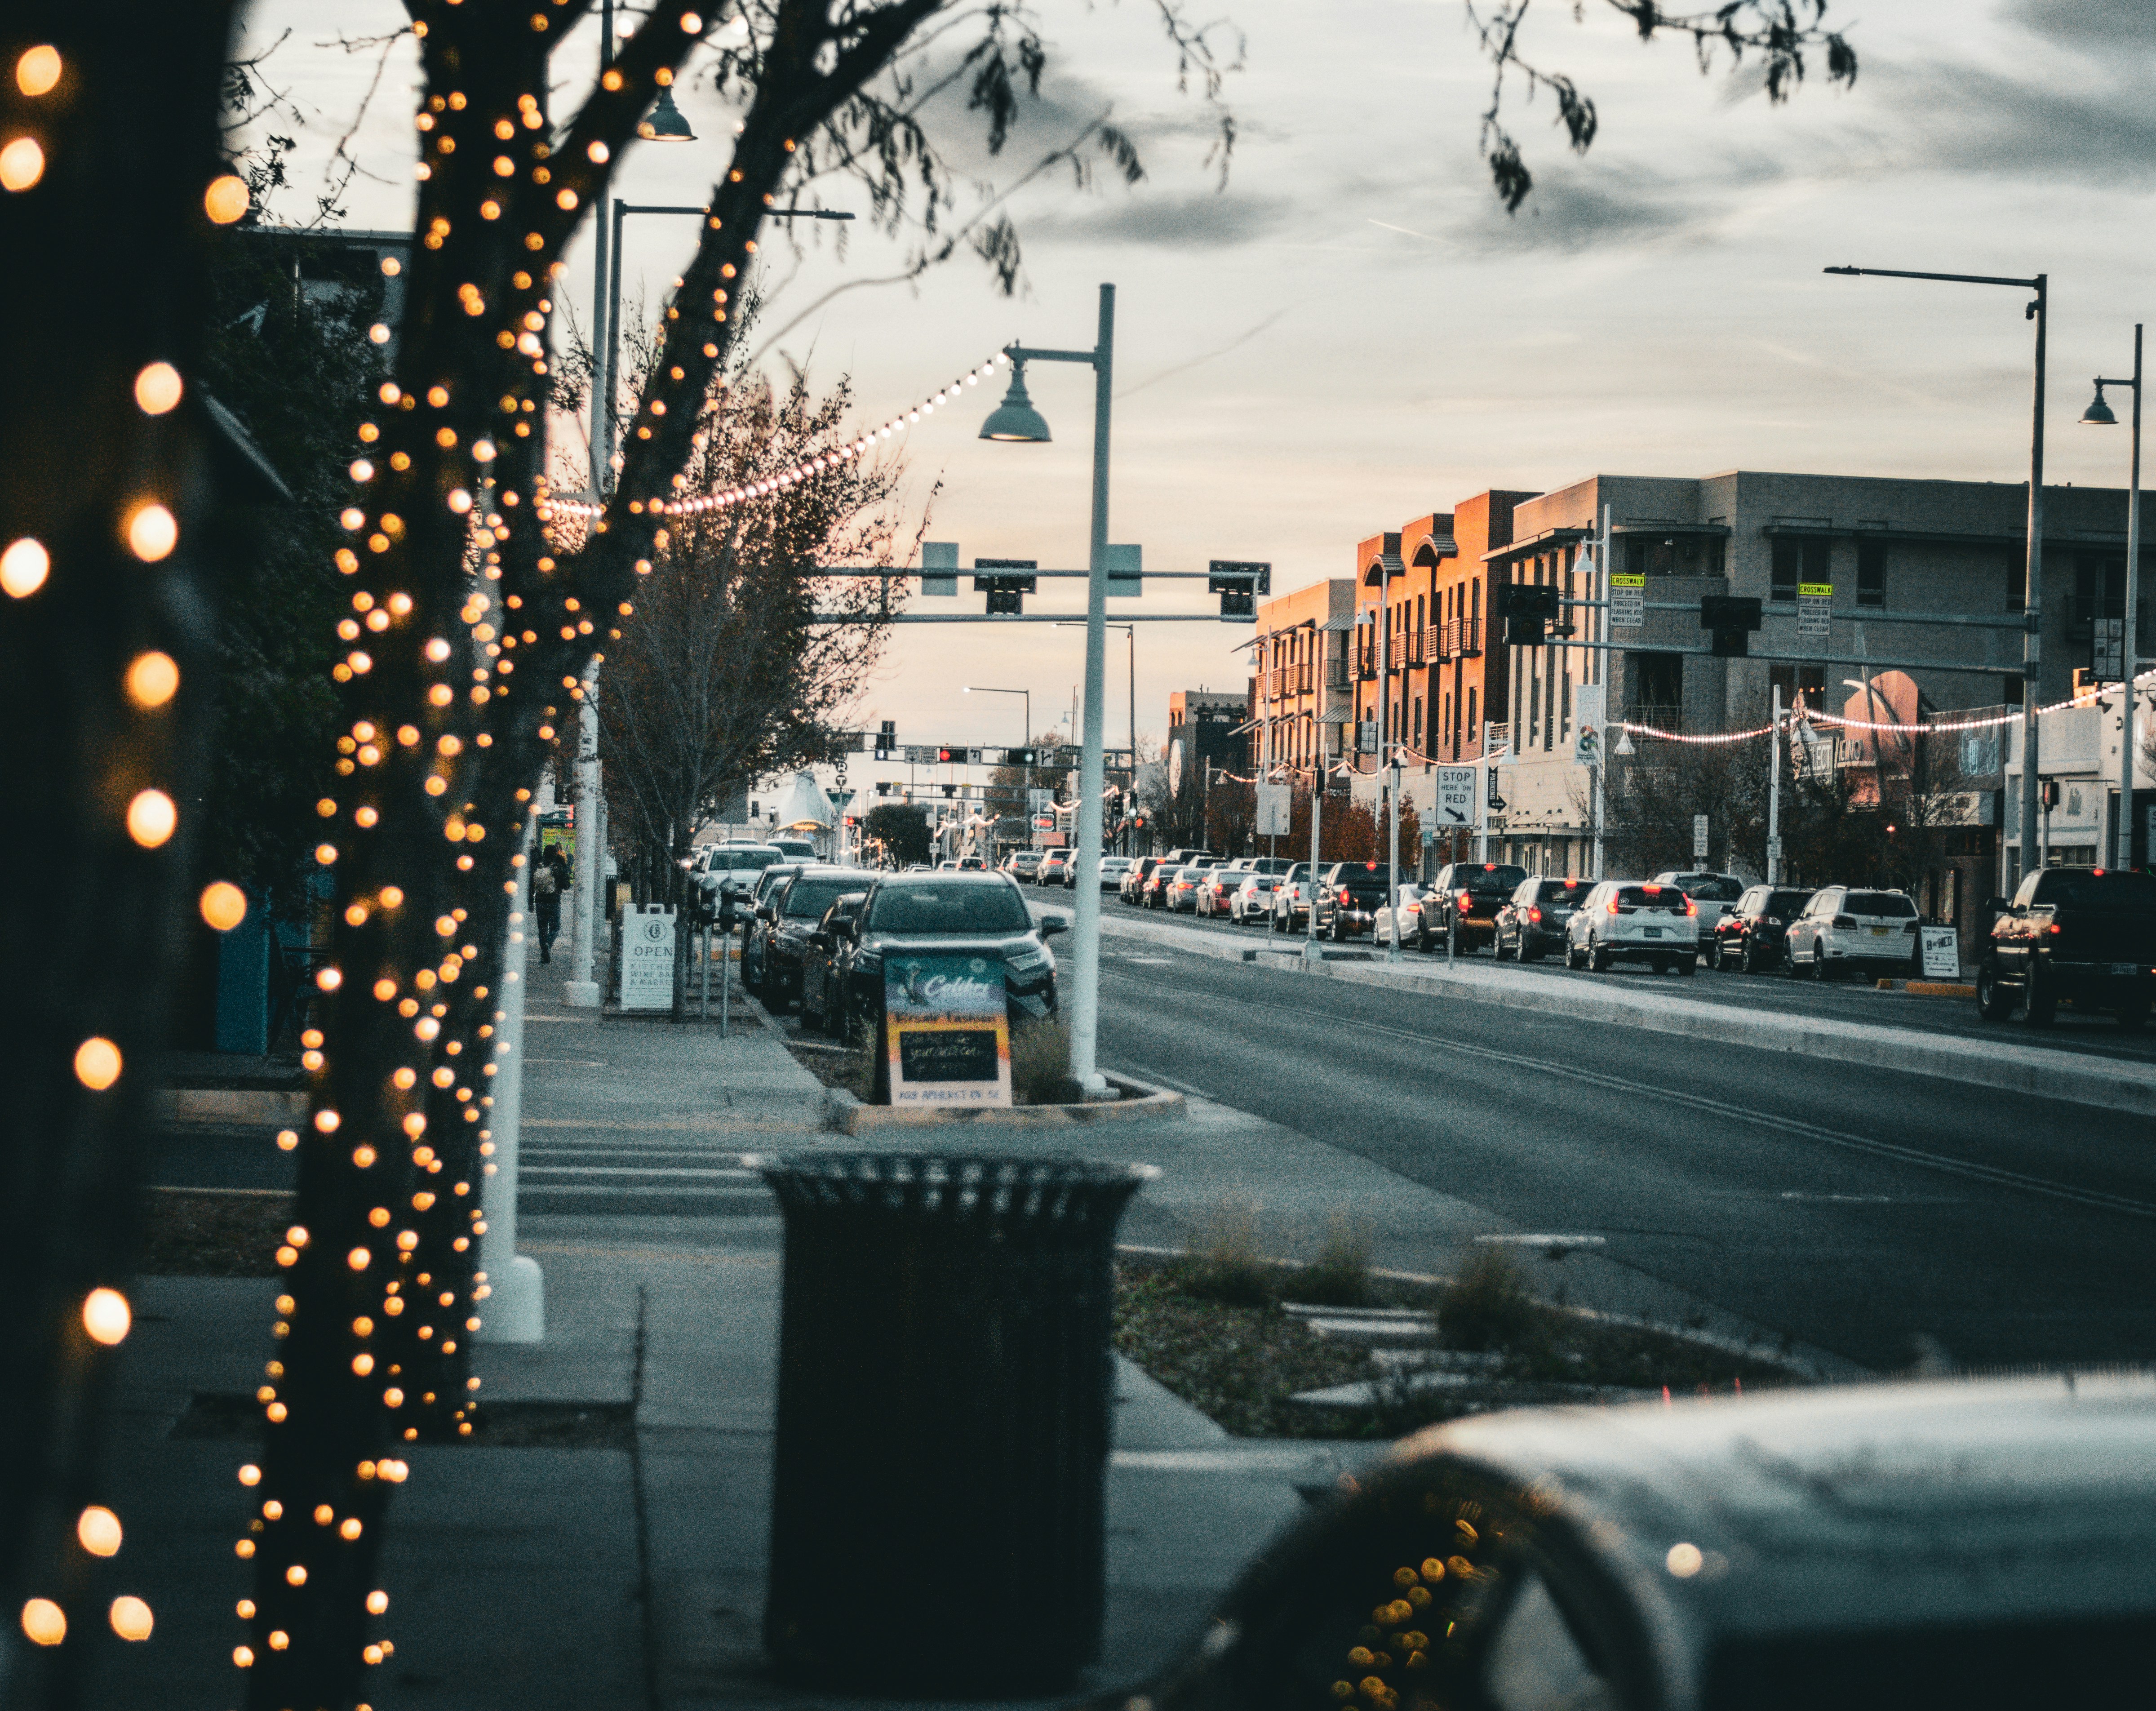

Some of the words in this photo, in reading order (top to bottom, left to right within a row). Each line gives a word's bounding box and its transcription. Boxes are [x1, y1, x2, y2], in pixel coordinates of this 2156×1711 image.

[1443, 772, 1471, 782] STOP
[1446, 794, 1466, 803] RED
[634, 946, 673, 957] OPEN
